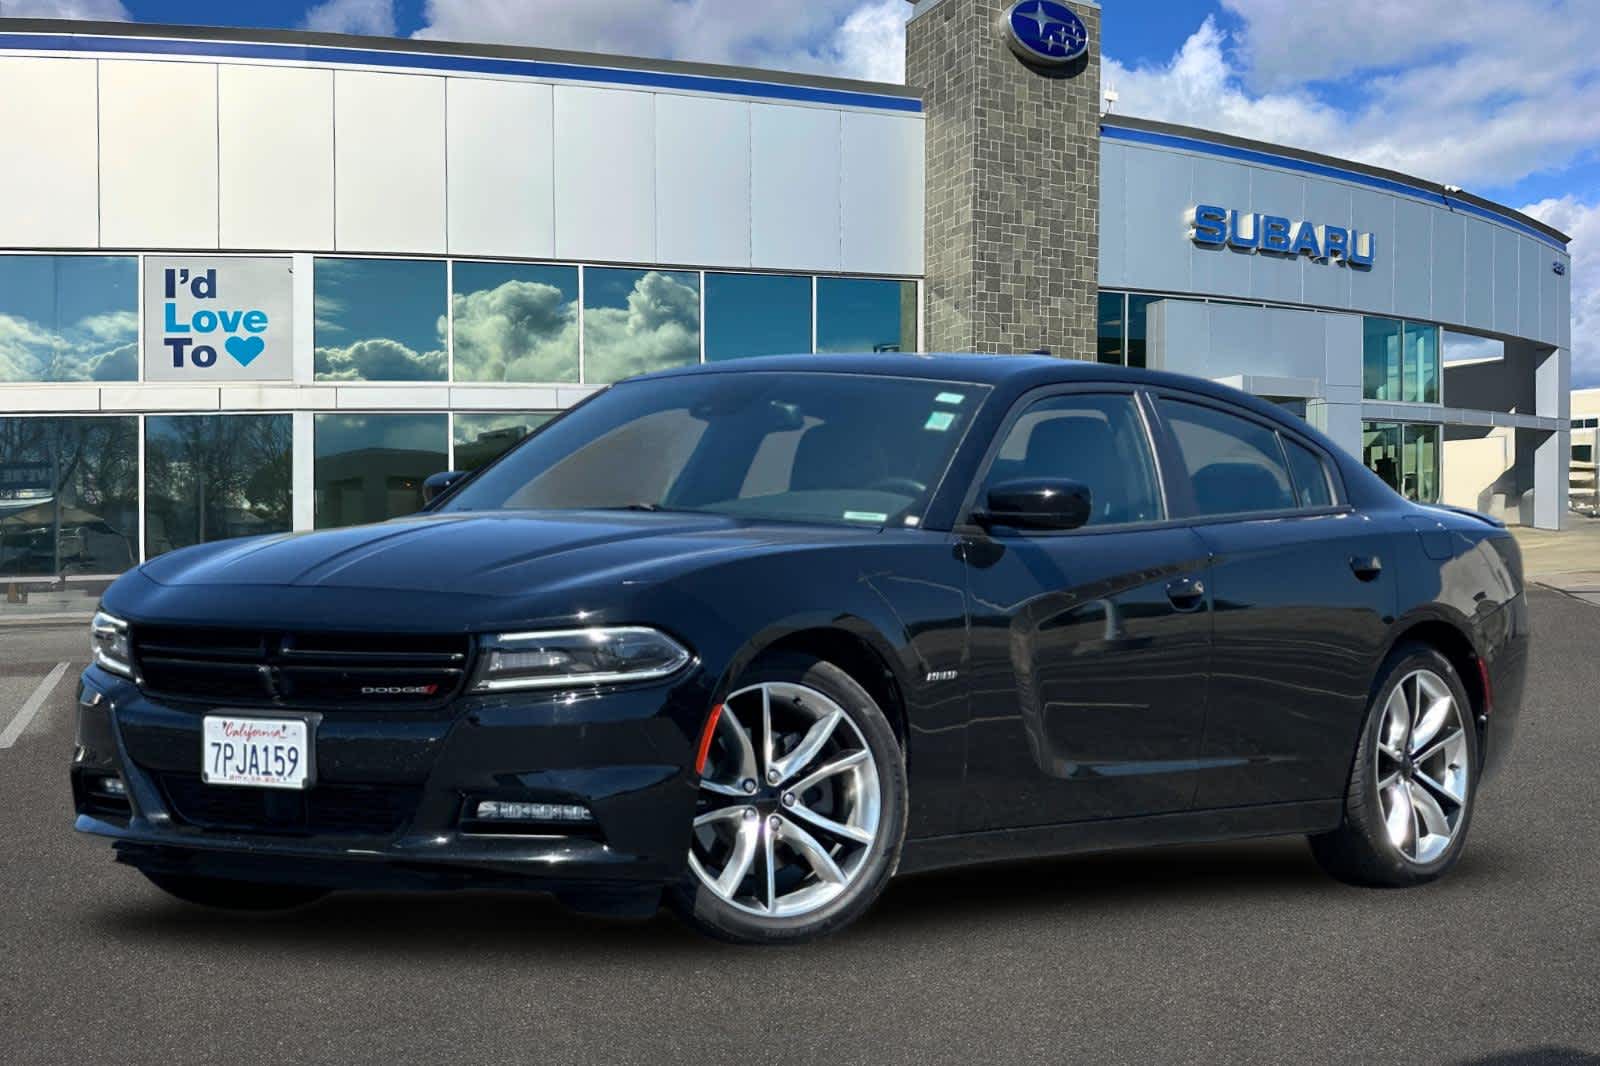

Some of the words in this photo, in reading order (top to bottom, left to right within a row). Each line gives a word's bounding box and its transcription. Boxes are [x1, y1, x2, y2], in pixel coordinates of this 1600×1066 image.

[1195, 204, 1376, 267] SUBARU
[165, 268, 217, 299] I'd
[165, 302, 268, 333] Love
[164, 337, 217, 368] To
[361, 685, 425, 694] DODGE
[224, 721, 282, 742] California
[211, 742, 299, 778] 7PJA159
